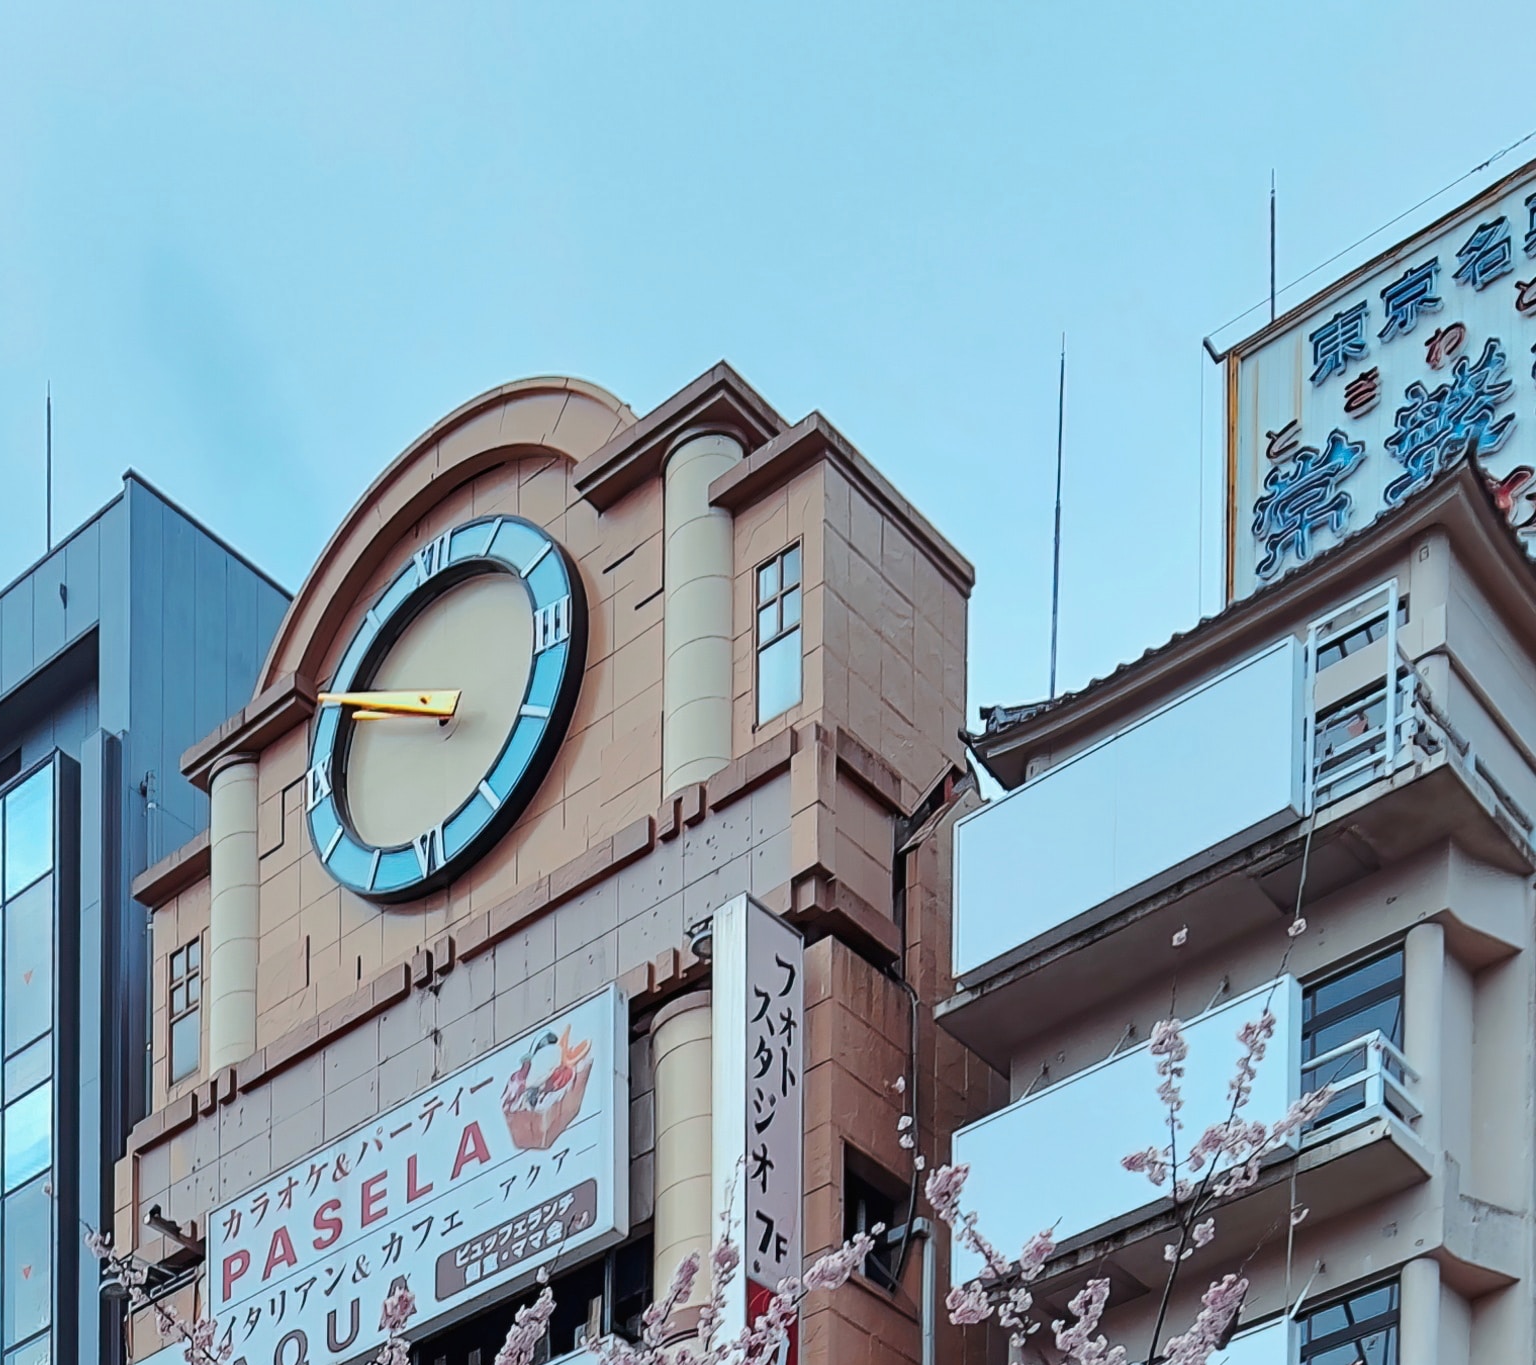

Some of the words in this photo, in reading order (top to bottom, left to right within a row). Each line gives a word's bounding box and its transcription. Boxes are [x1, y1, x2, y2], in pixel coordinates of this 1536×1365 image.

[1310, 192, 1536, 387] 東京名
[750, 984, 776, 1194] スタジオ
[775, 953, 797, 1097] フォト
[222, 1076, 494, 1243] カラオケ&パーティー
[222, 1120, 491, 1302] PASELA
[455, 1192, 575, 1268] ビュッフェランチ
[220, 1209, 464, 1348] イタリアン&カフェ
